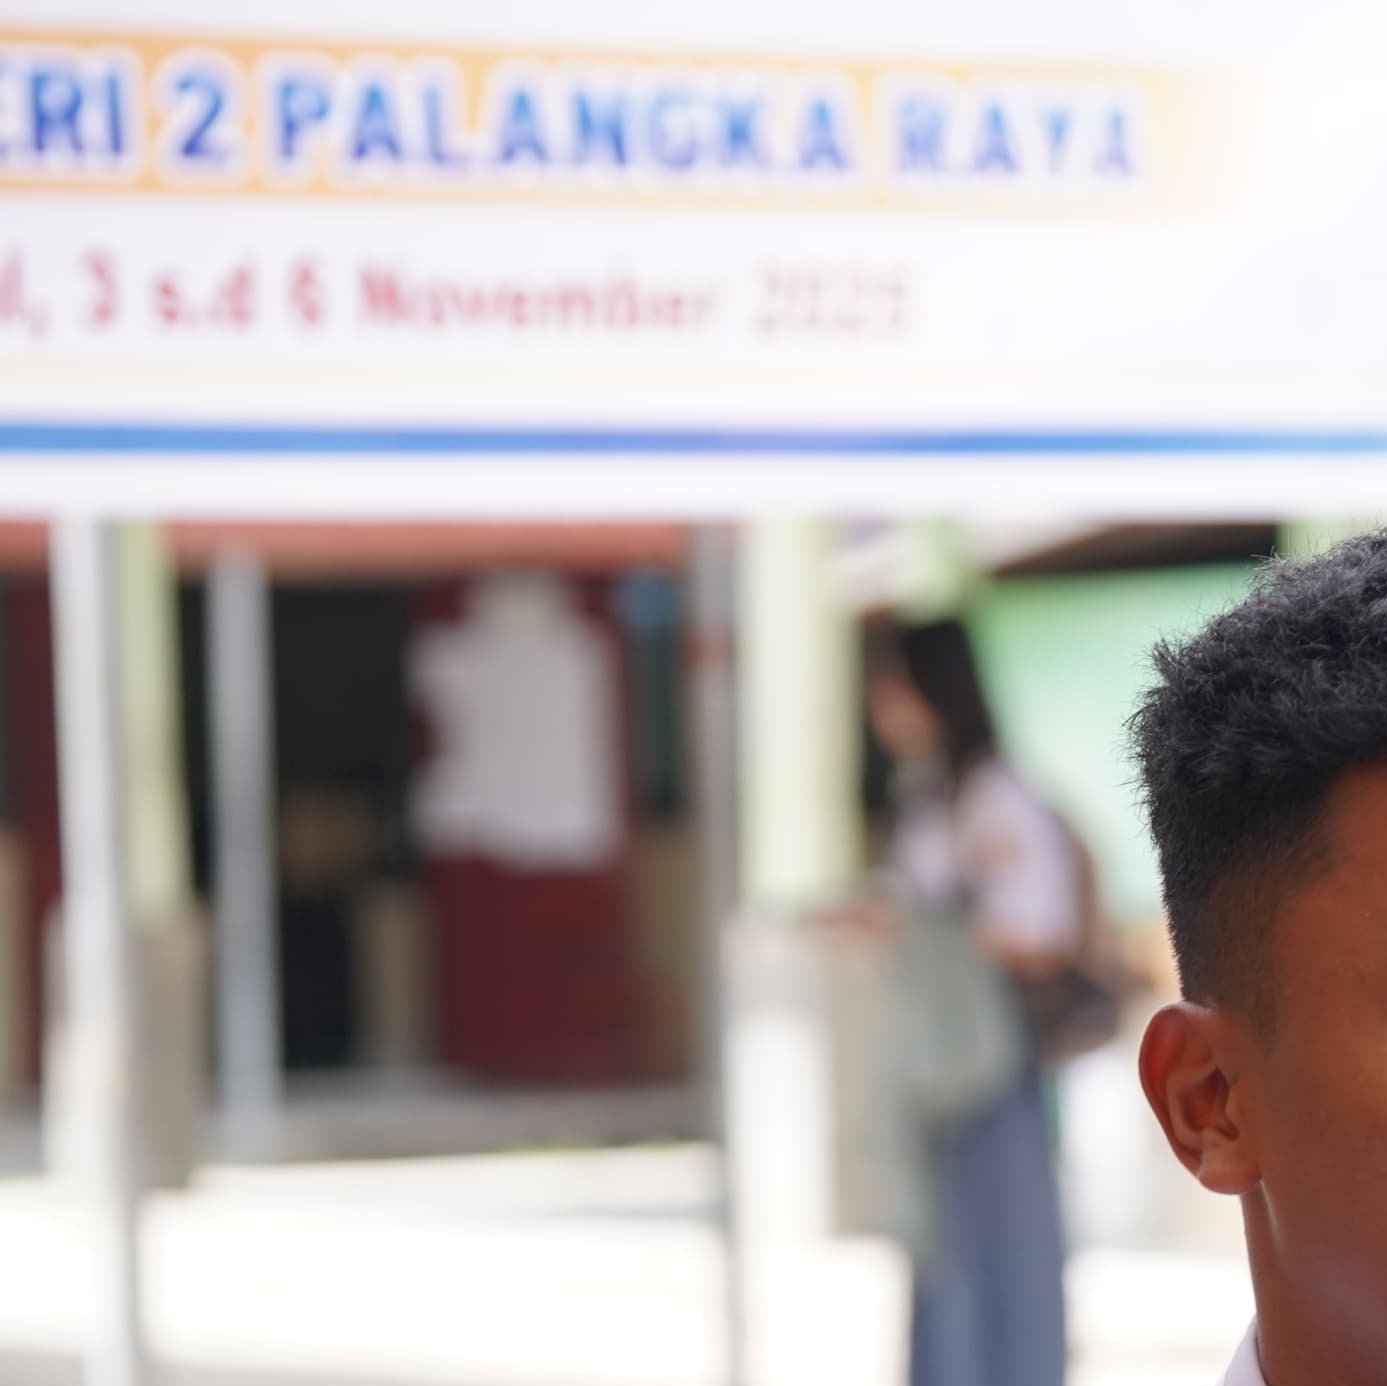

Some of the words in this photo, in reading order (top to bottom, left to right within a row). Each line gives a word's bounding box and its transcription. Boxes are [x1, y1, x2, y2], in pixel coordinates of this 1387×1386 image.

[0, 68, 124, 157] RI
[174, 72, 229, 160] 2
[275, 79, 853, 175] PALANGKA
[894, 92, 1143, 181] RAYA
[79, 246, 119, 331] 3
[356, 264, 718, 332] November
